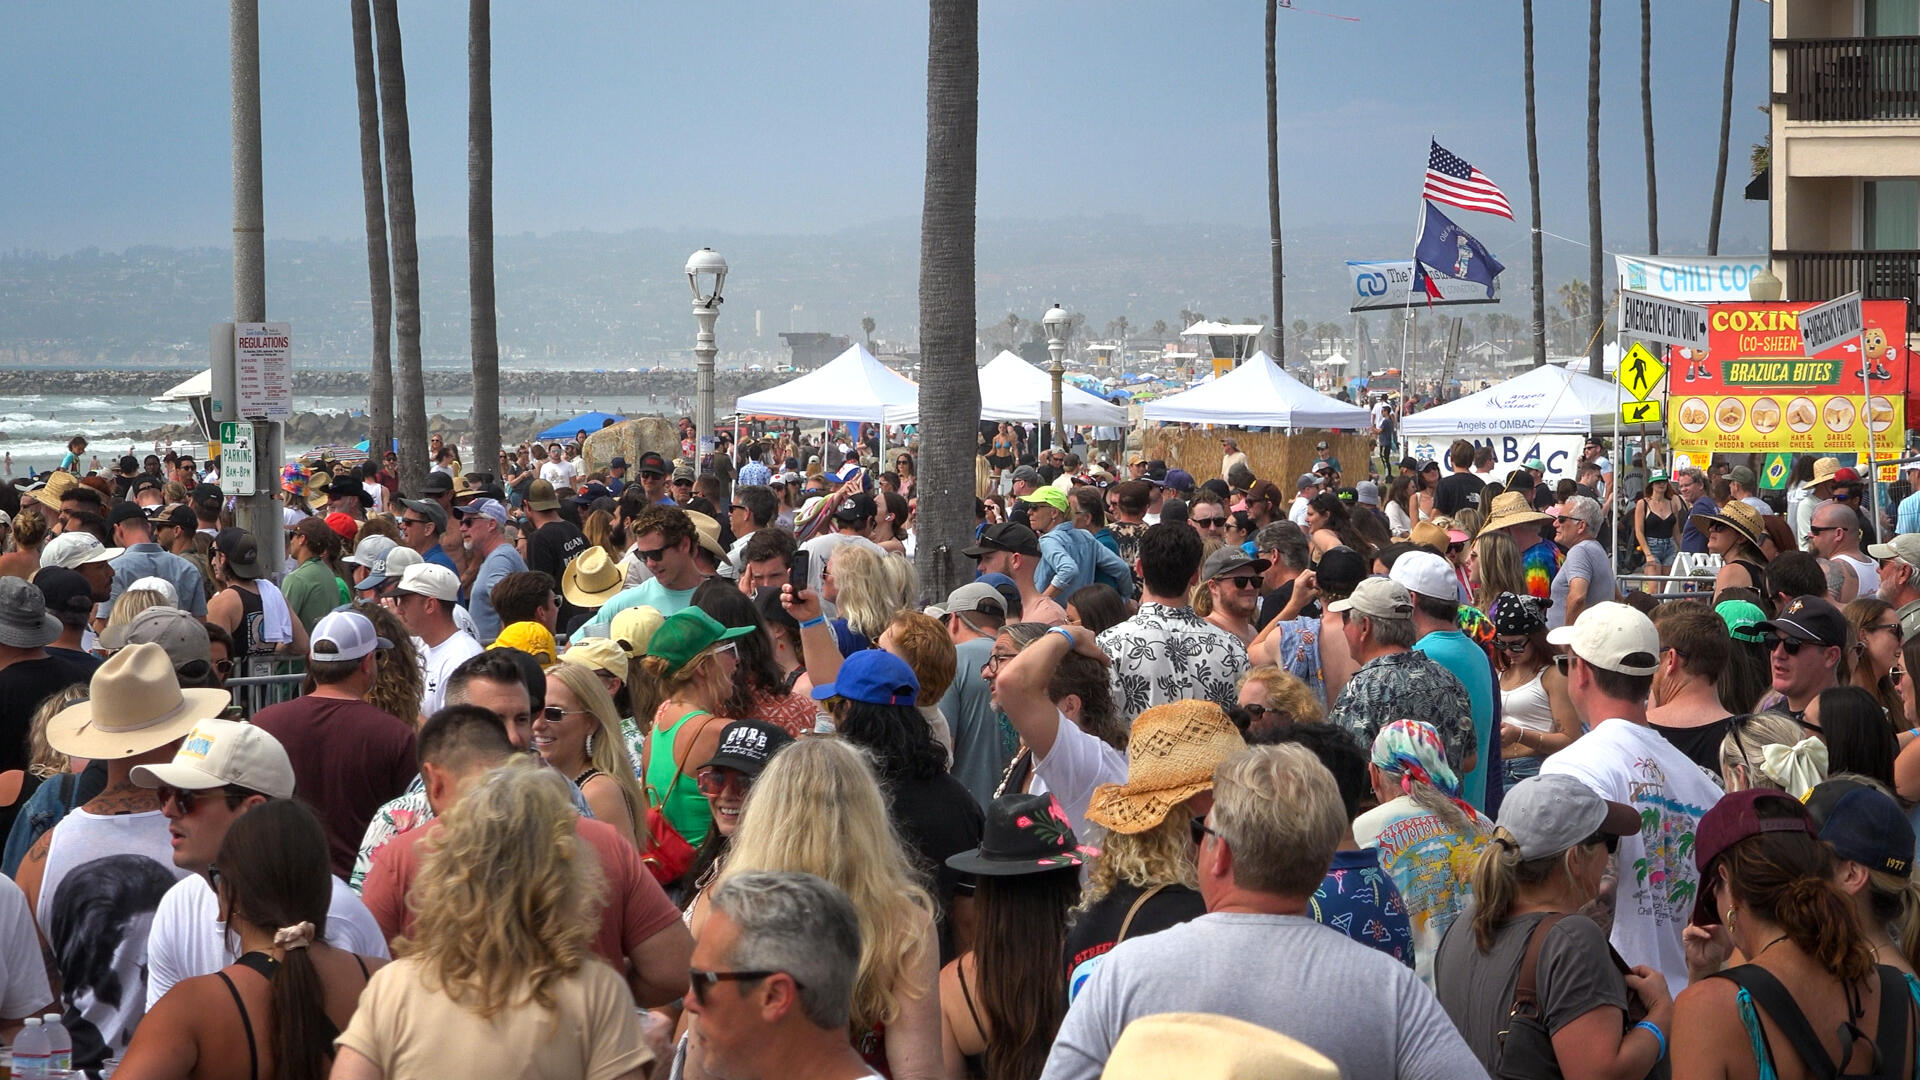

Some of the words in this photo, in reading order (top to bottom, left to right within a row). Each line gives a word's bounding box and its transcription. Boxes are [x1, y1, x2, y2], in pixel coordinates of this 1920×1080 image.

[1387, 268, 1408, 283] The
[1659, 266, 1712, 292] CHILI
[1625, 297, 1666, 335] EMERGENCY
[1667, 306, 1681, 338] EXIT
[1682, 309, 1699, 342] ONLY
[1807, 307, 1839, 347] EMERGENCY
[1835, 303, 1849, 336] EXIT
[239, 336, 289, 348] REGULATIONS
[1730, 363, 1788, 382] BRAZUCA
[1793, 362, 1834, 382] BITES
[1457, 421, 1486, 432] Angels
[1488, 420, 1498, 429] of
[1499, 419, 1535, 429] OMBAC
[225, 426, 232, 442] 4
[1680, 438, 1708, 446] CHICKEN
[1714, 441, 1745, 449] CHEDDAR
[1790, 441, 1815, 449] CHEESE
[223, 449, 252, 463] PARKING
[225, 466, 251, 478] 8AM-8PM
[1376, 815, 1448, 870] SUMME
[1886, 857, 1905, 871] 1977
